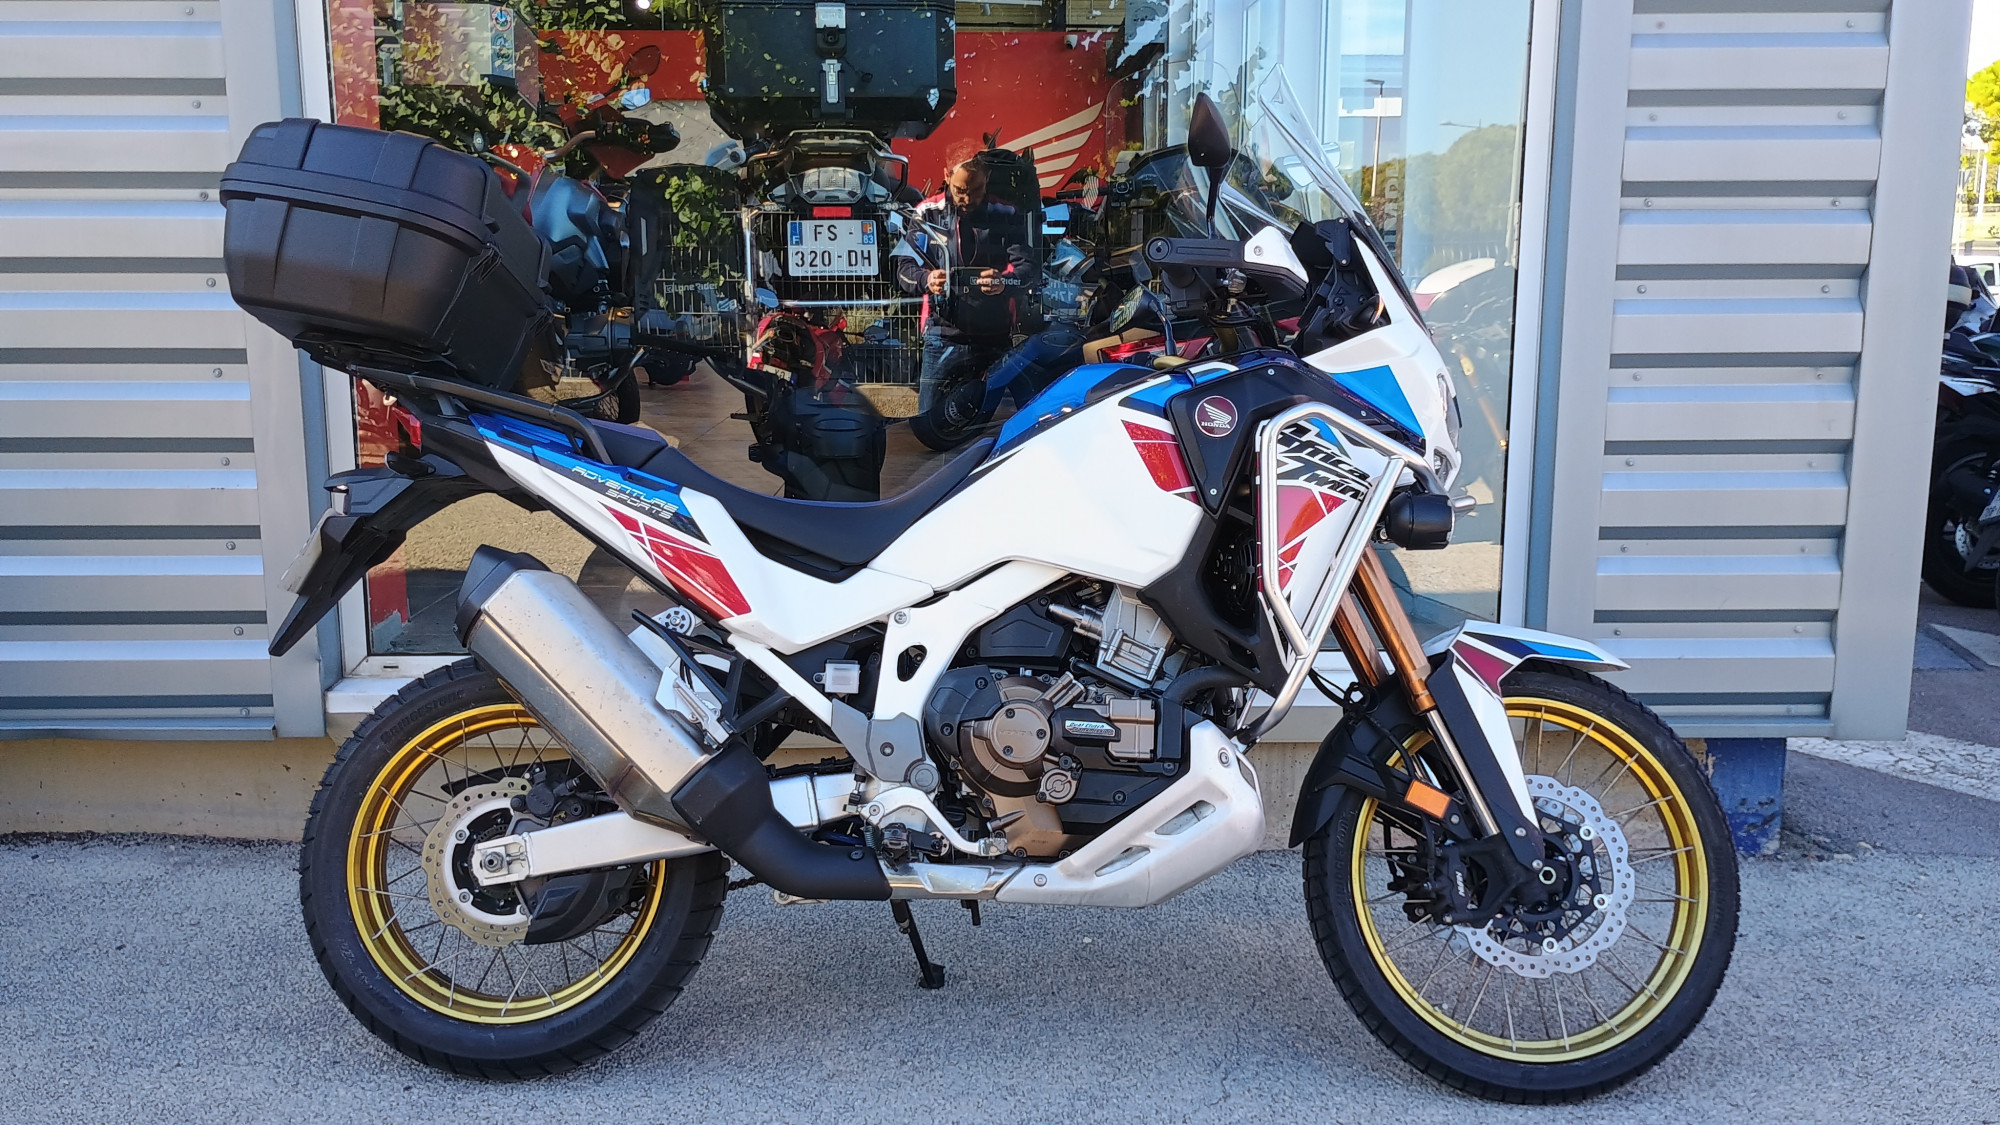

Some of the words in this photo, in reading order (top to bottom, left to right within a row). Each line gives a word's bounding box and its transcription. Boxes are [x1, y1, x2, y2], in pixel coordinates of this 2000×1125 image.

[792, 235, 801, 245] F
[814, 224, 838, 242] FS
[863, 235, 874, 244] 83
[794, 249, 872, 268] 320-DH
[1201, 421, 1231, 429] HONDA
[1277, 422, 1371, 482] Africa
[1277, 456, 1365, 501] Twin
[571, 465, 680, 513] ADVENTURE
[605, 488, 674, 520] SPORTS
